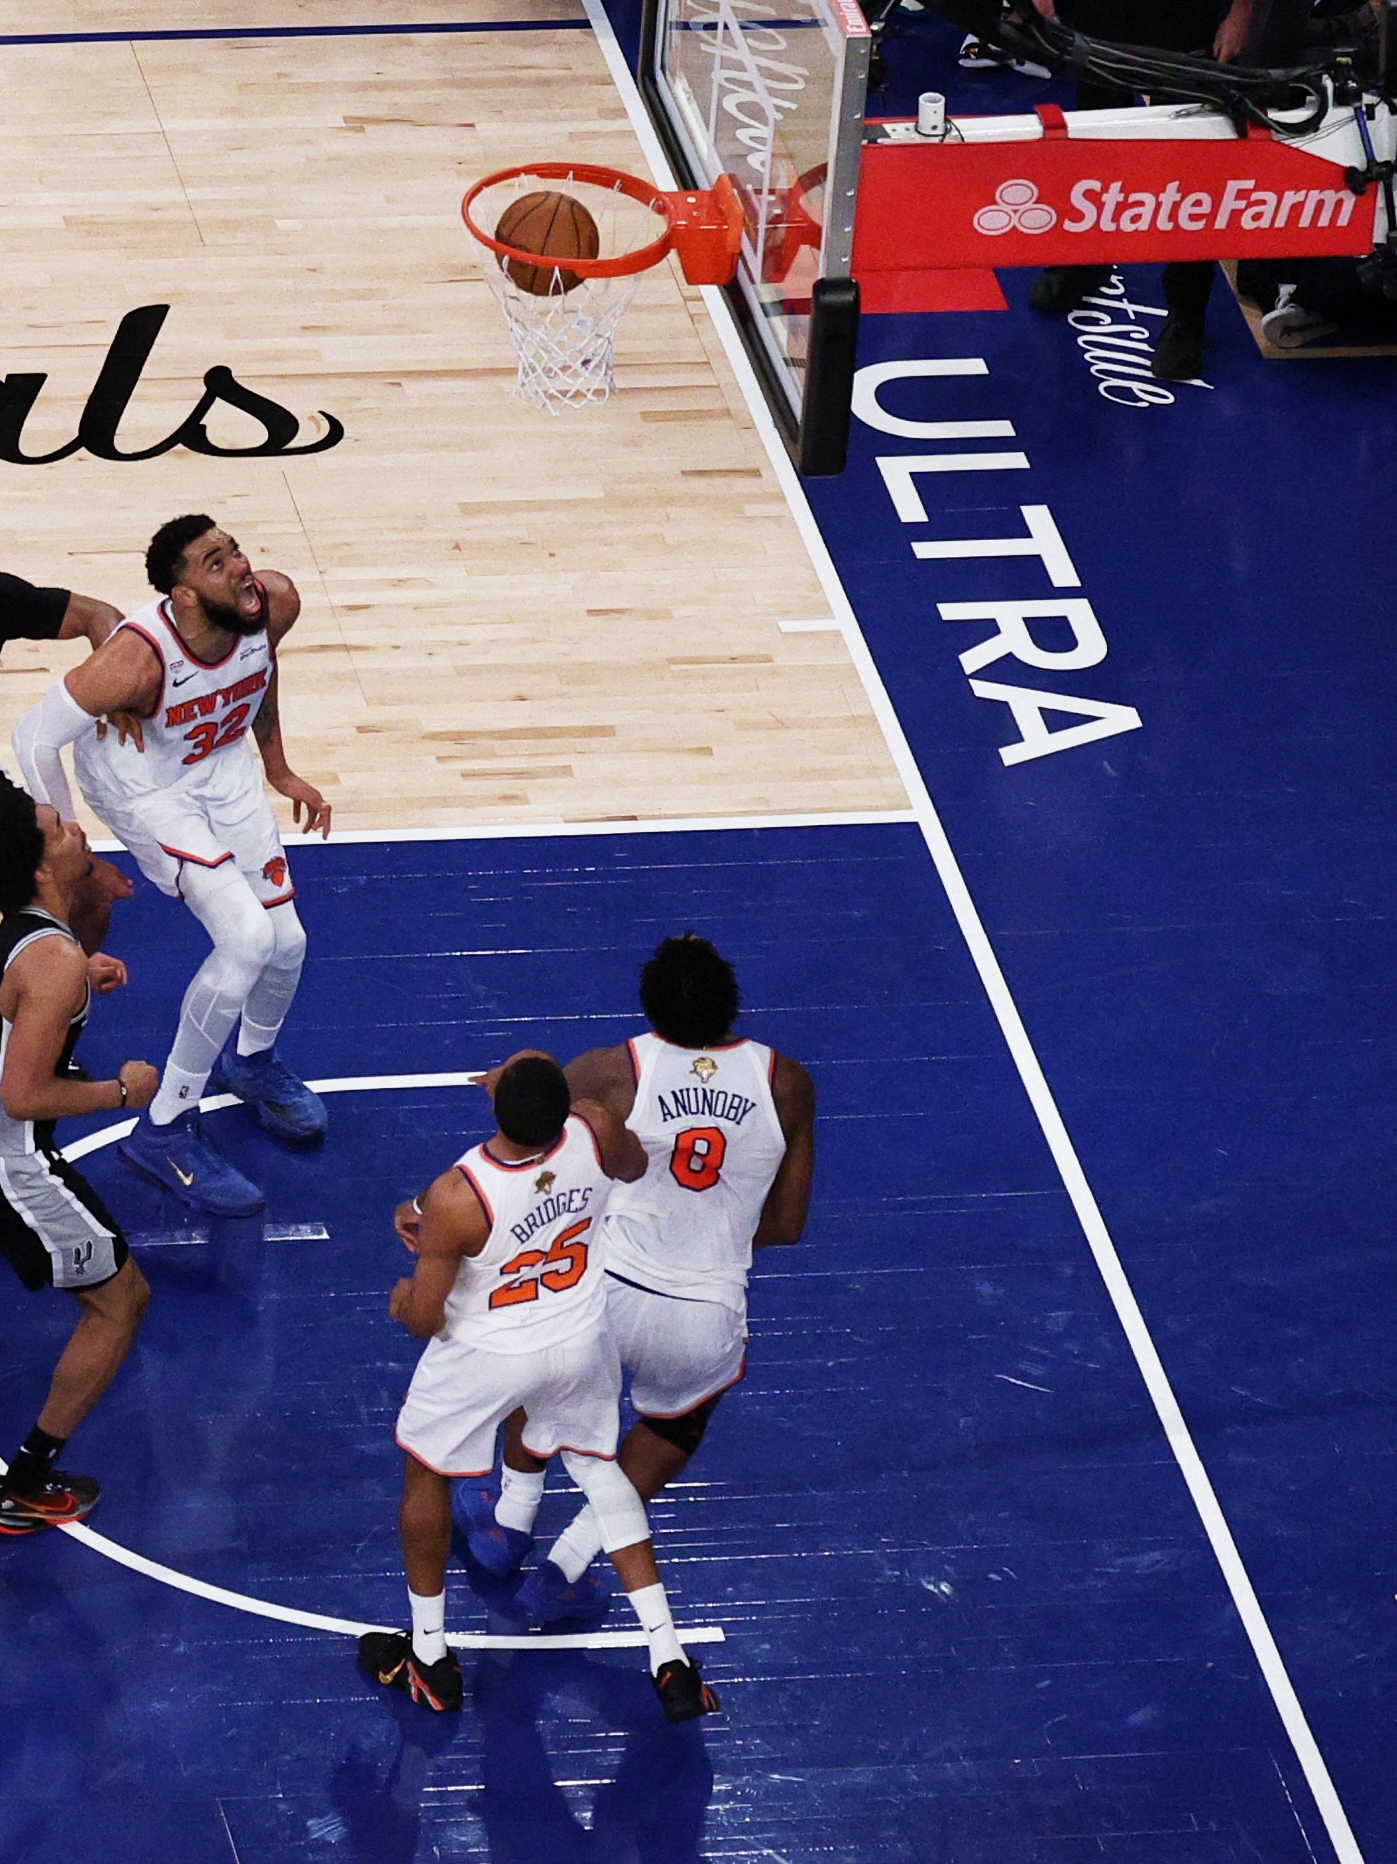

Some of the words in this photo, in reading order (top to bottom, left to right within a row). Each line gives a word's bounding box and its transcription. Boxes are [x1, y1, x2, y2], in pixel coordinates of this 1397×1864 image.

[851, 357, 1143, 767] ULTRA
[165, 690, 219, 728] NEW
[181, 703, 251, 765] 32
[657, 1087, 757, 1126] ANUNOBY
[669, 1126, 727, 1192] 8
[510, 1187, 593, 1245] BRIDGES
[488, 1216, 593, 1311] 25
